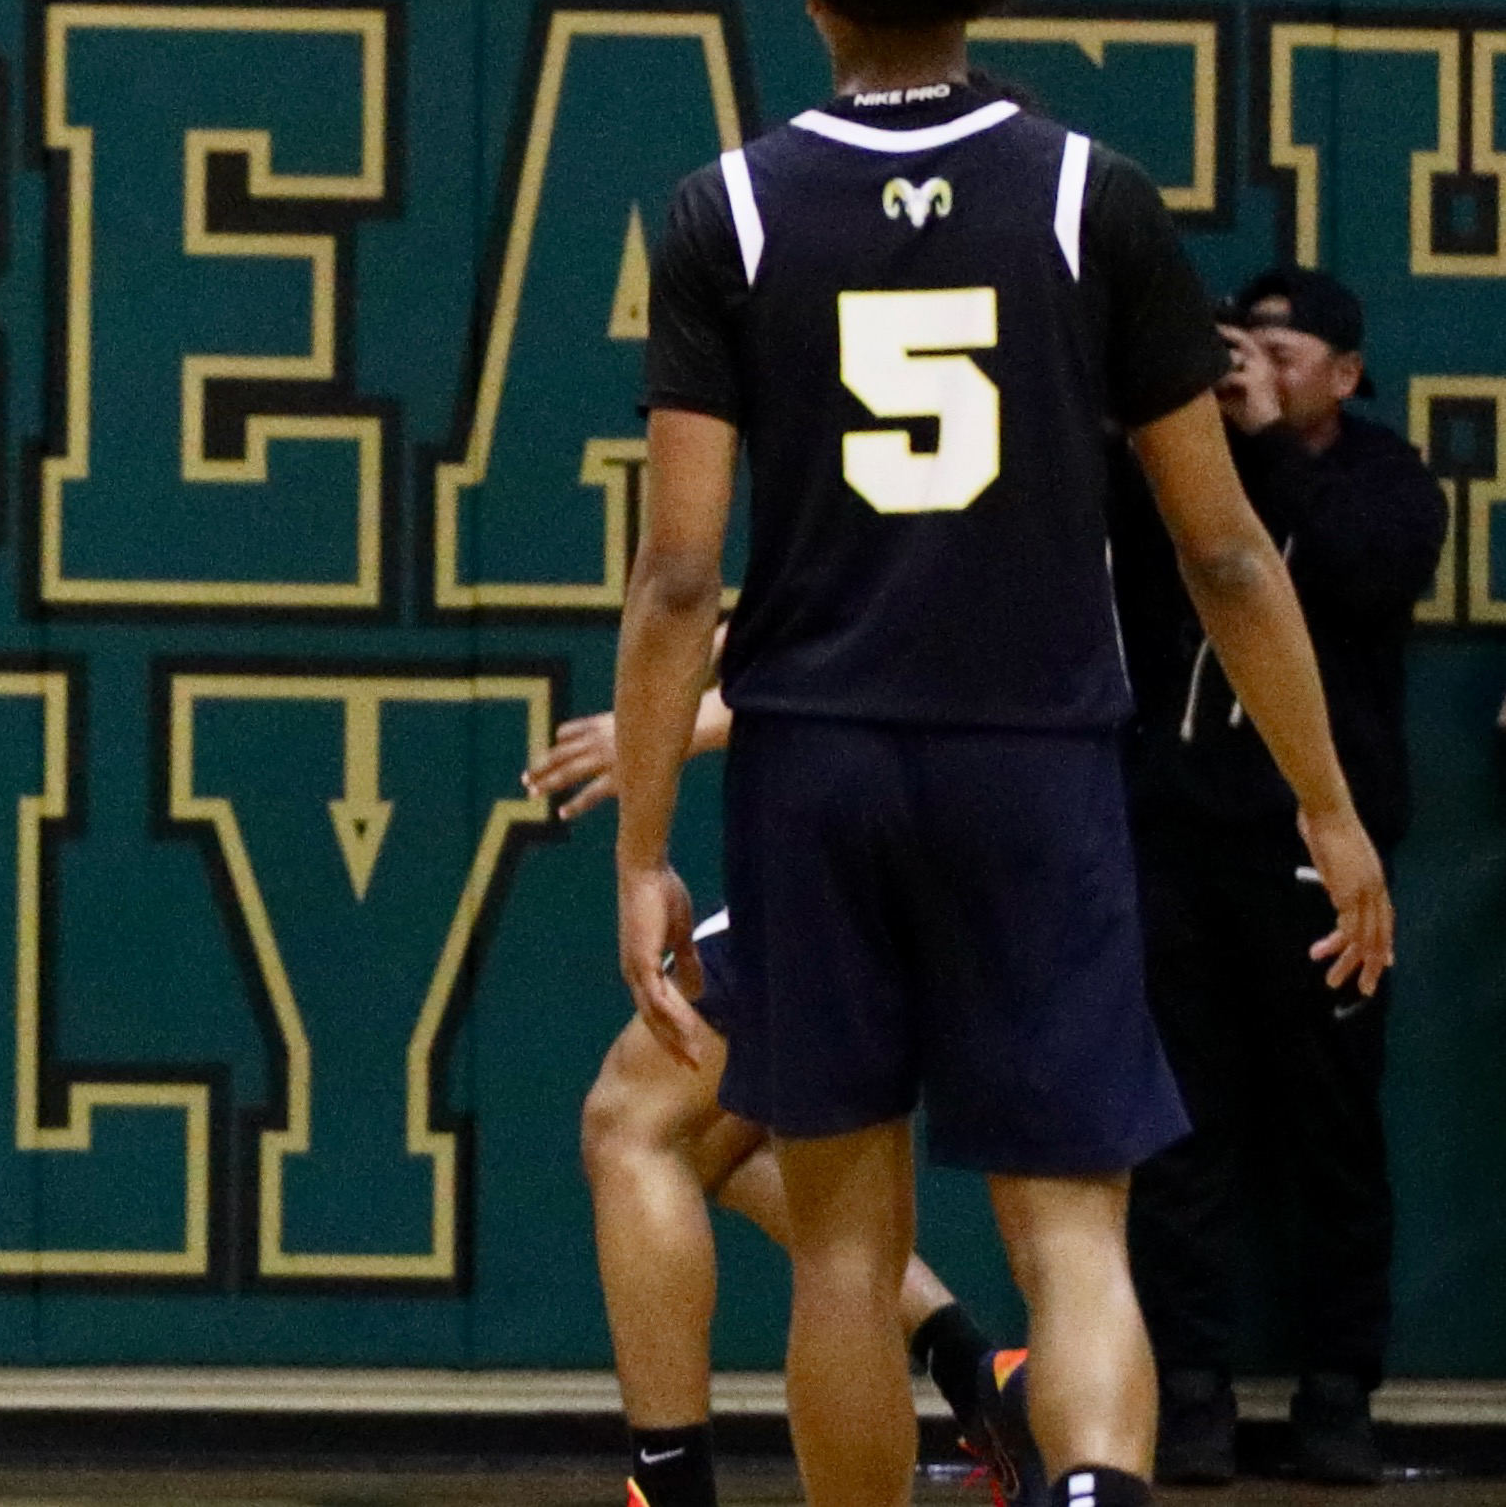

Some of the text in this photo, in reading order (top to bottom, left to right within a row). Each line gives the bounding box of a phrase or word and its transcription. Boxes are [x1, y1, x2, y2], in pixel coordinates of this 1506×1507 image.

[853, 82, 951, 107] NIKE PRO
[838, 286, 1000, 514] 5
